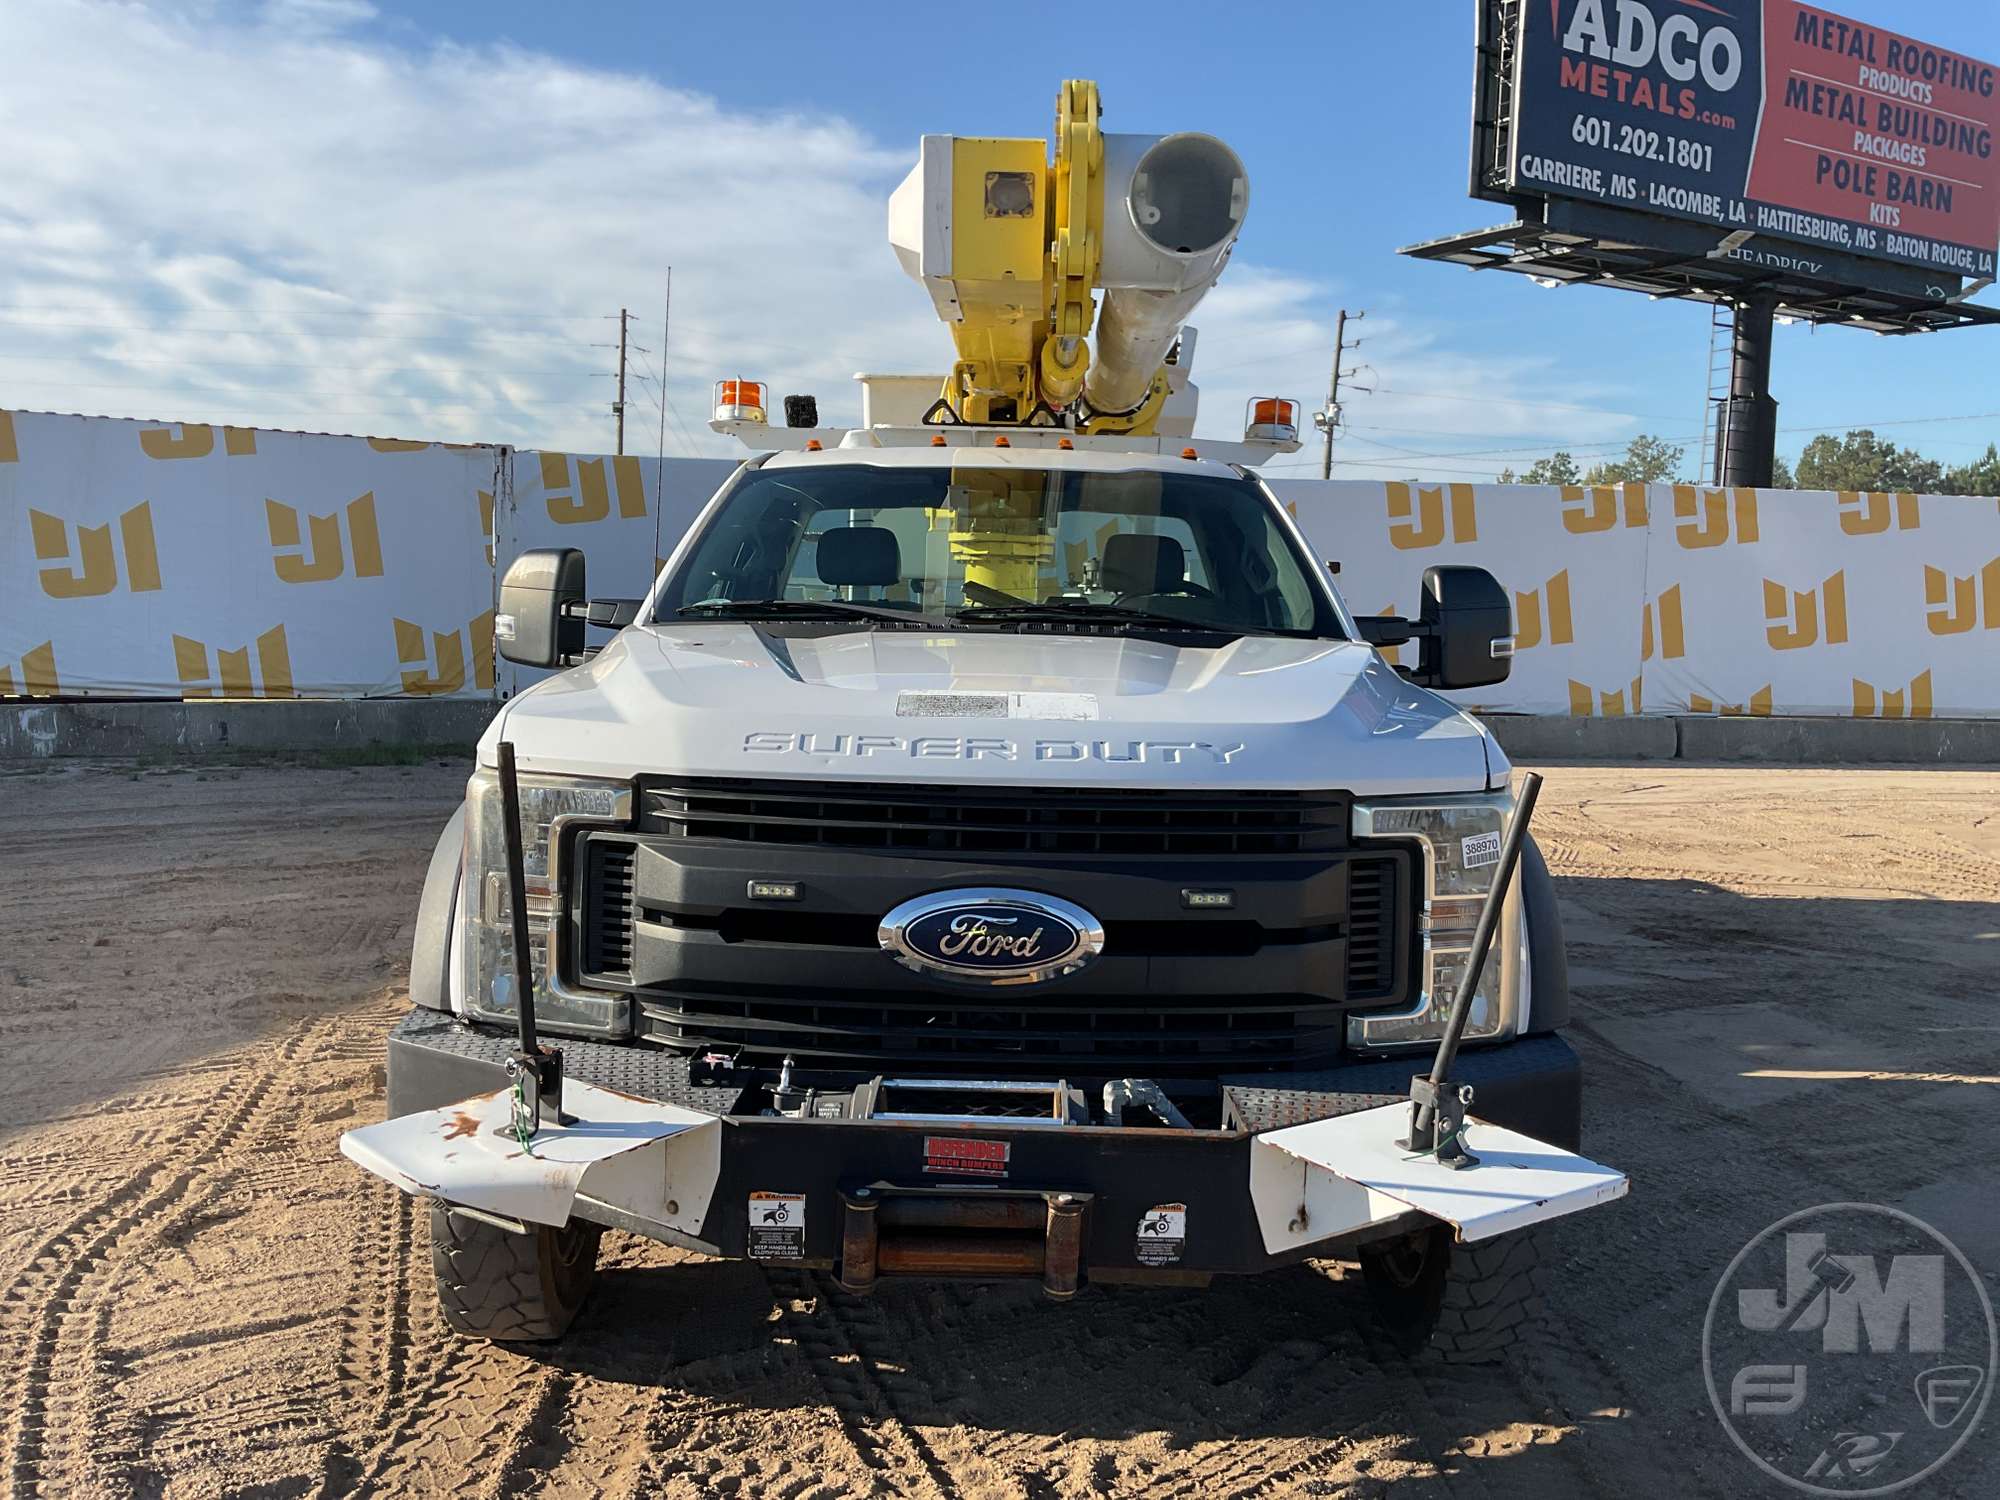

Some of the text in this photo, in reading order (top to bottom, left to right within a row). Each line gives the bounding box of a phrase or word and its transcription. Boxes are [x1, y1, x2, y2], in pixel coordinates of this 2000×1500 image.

[1563, 0, 1741, 92] ADCO
[1794, 11, 1994, 97] METAL ROOFING
[1560, 56, 1736, 129] METALS.com
[1858, 65, 1933, 104] PRODUCTS
[1571, 114, 1713, 173] 601.202.1801
[1784, 77, 1992, 159] METAL BUILDING
[1854, 130, 1927, 167] PACKAGES
[1816, 154, 1953, 213] POLE BARN
[1520, 154, 1993, 273] CARRIERE, MS LACOMBE, LA HATTIESBURG, MS BATON ROUGE, LA
[1869, 202, 1901, 227] KITS
[743, 732, 1247, 765] SUPER DUTY
[1465, 838, 1498, 856] 388970
[939, 913, 1044, 958] Ford
